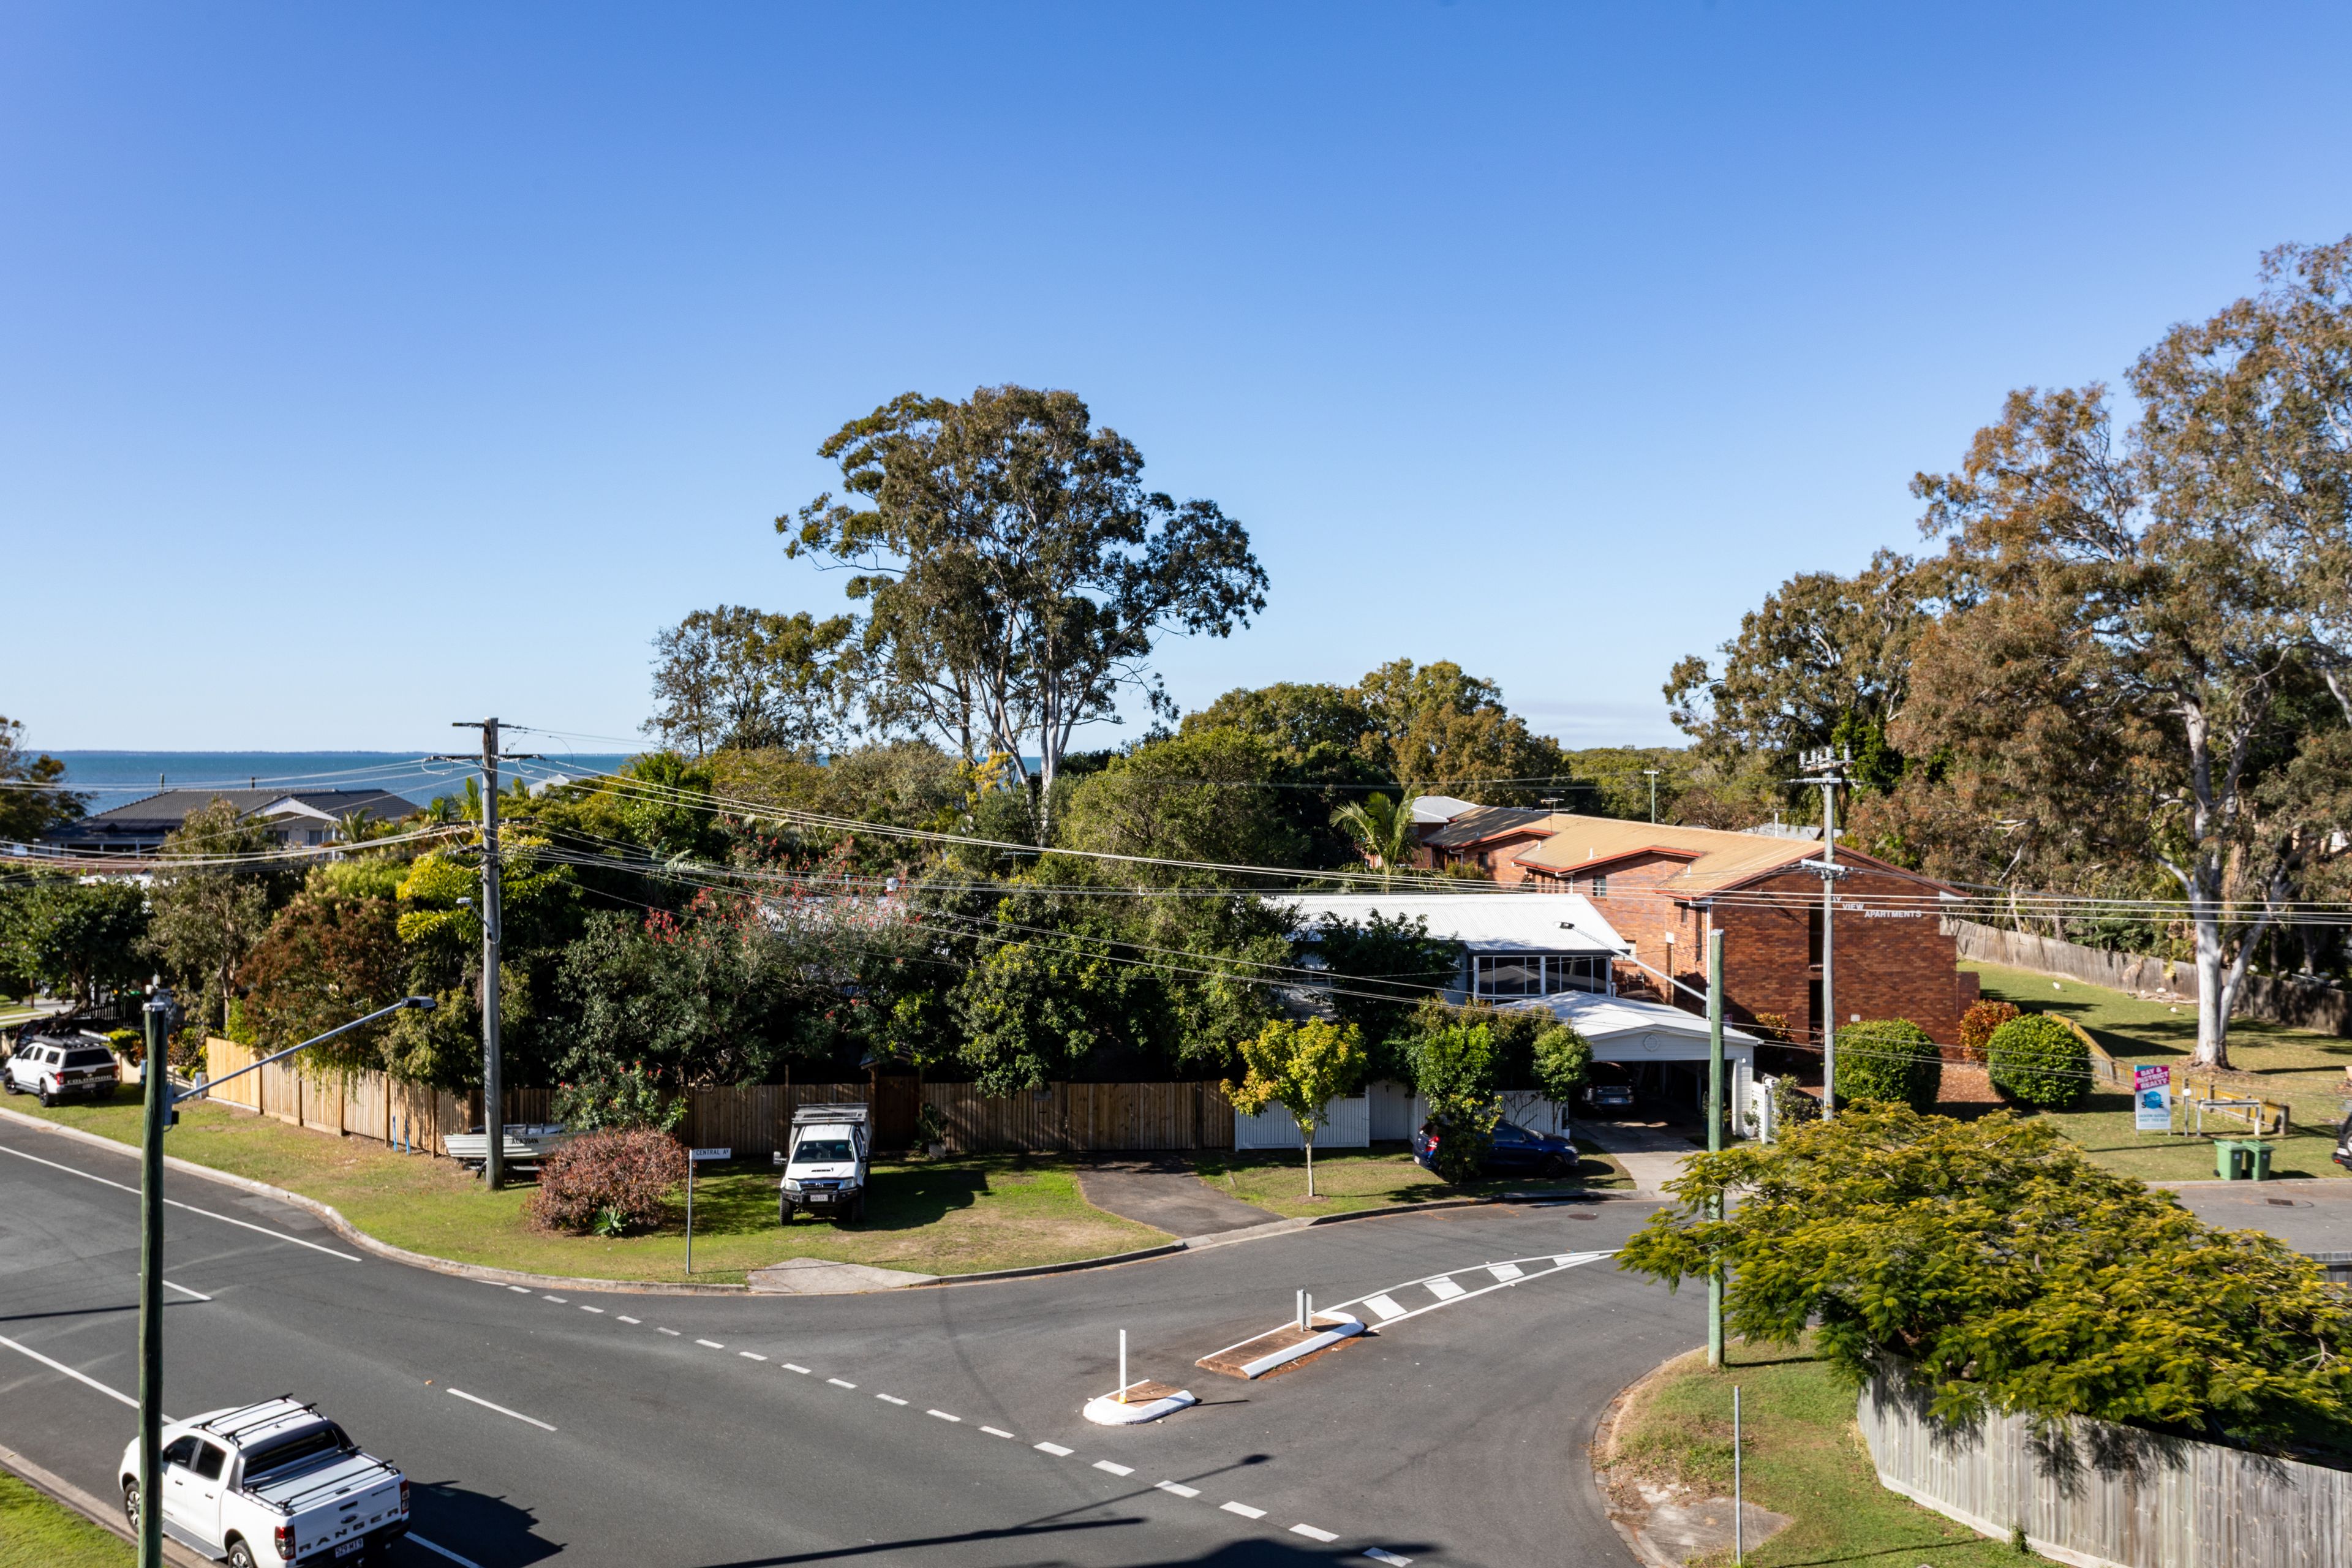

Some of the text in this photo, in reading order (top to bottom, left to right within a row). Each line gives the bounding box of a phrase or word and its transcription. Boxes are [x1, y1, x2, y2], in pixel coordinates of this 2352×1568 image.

[2136, 1071, 2169, 1084] DISTRICT
[2140, 1068, 2155, 1077] BAY
[67, 1074, 112, 1084] COLORADO
[2140, 1078, 2167, 1089] REALTY
[298, 1507, 398, 1553] RANGER
